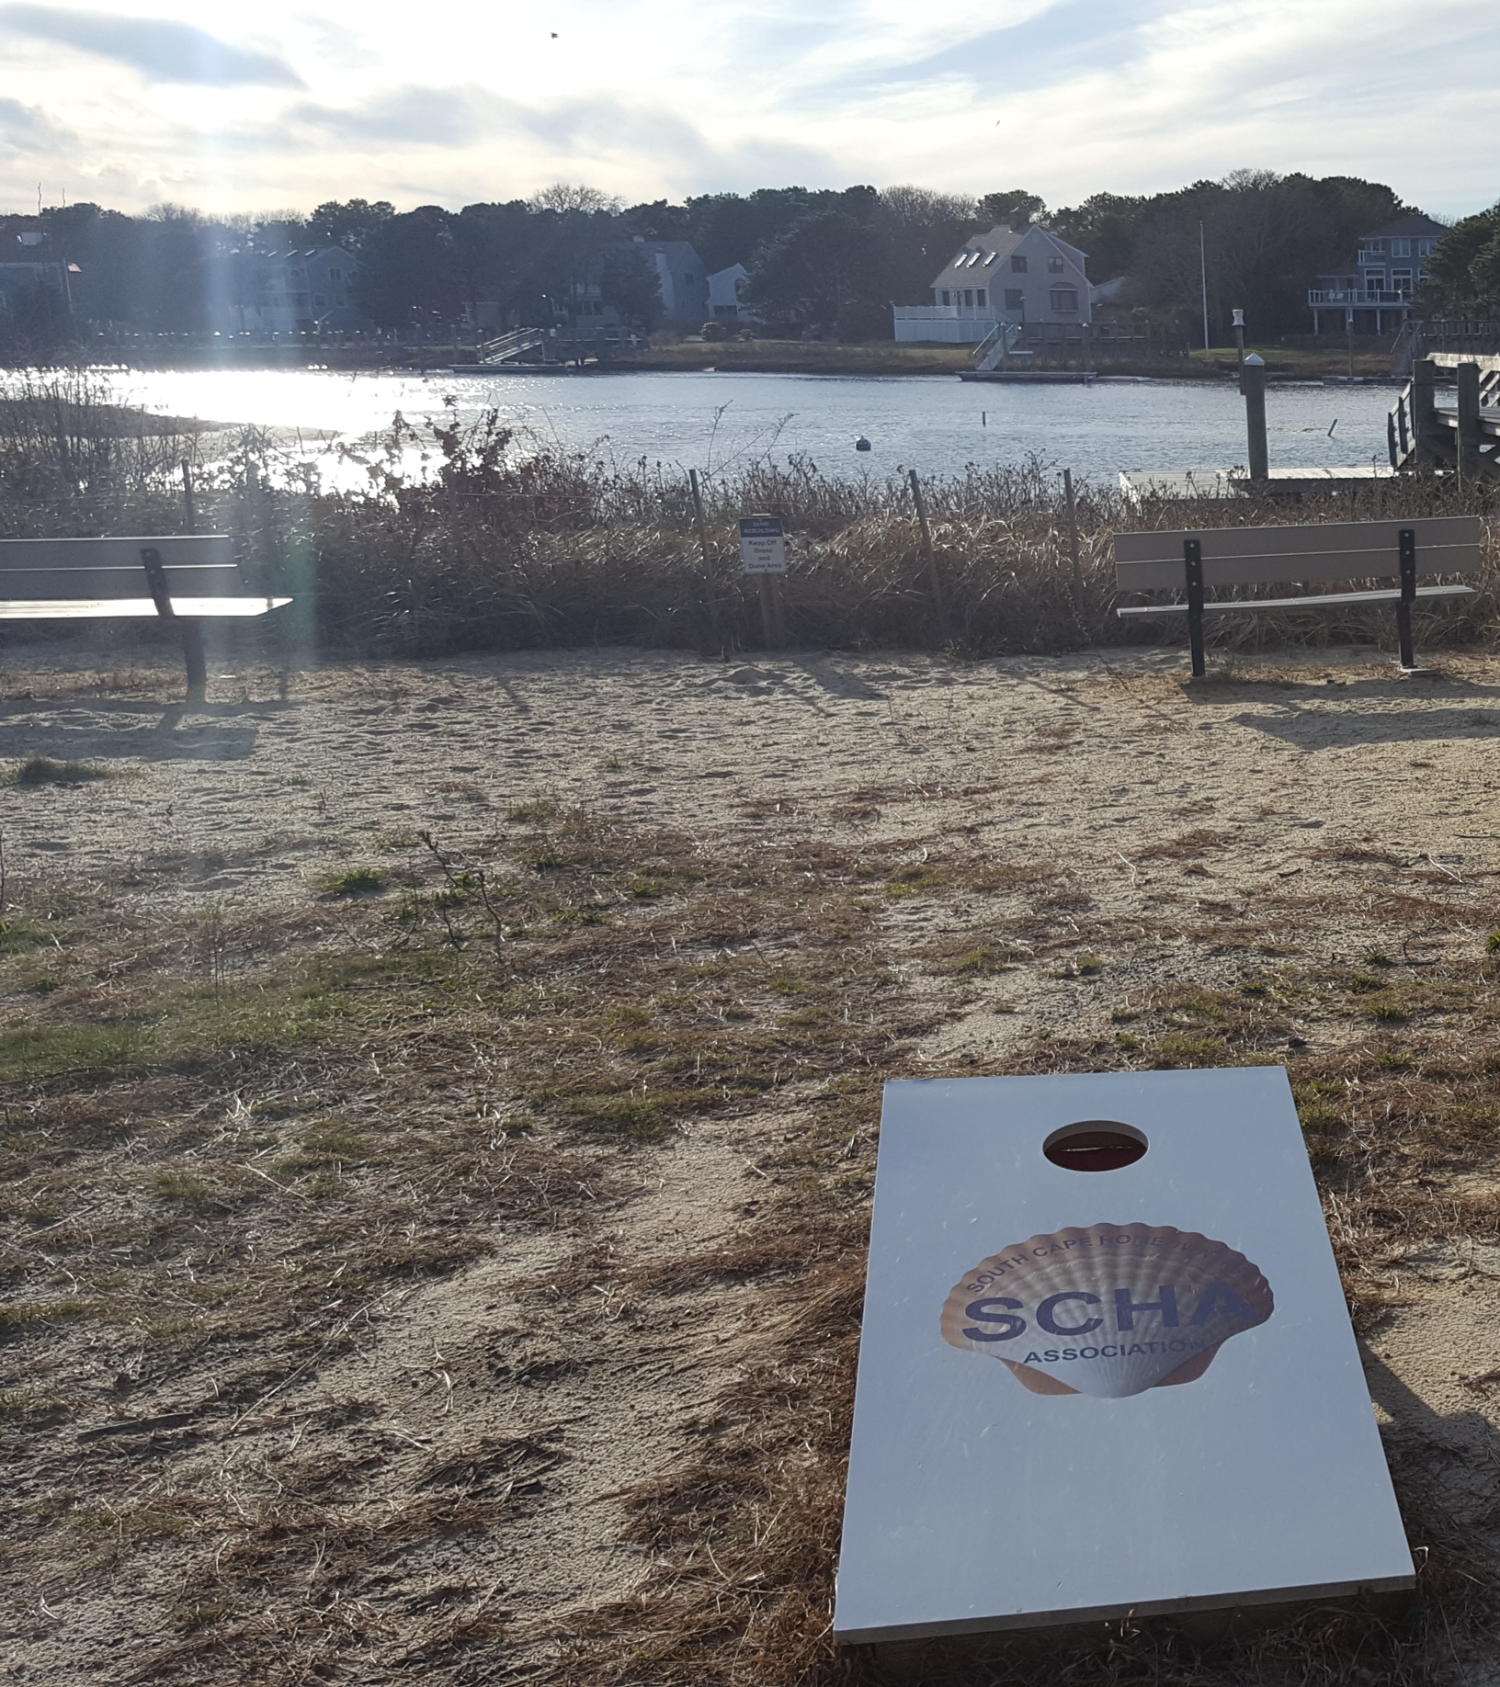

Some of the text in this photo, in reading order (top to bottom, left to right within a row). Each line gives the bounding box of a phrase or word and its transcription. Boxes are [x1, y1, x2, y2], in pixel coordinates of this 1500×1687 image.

[967, 1253, 1029, 1294] SOUTH
[1033, 1236, 1094, 1257] CAPE
[962, 1281, 1258, 1342] SCHA
[1023, 1339, 1208, 1363] ASSOCIATION
